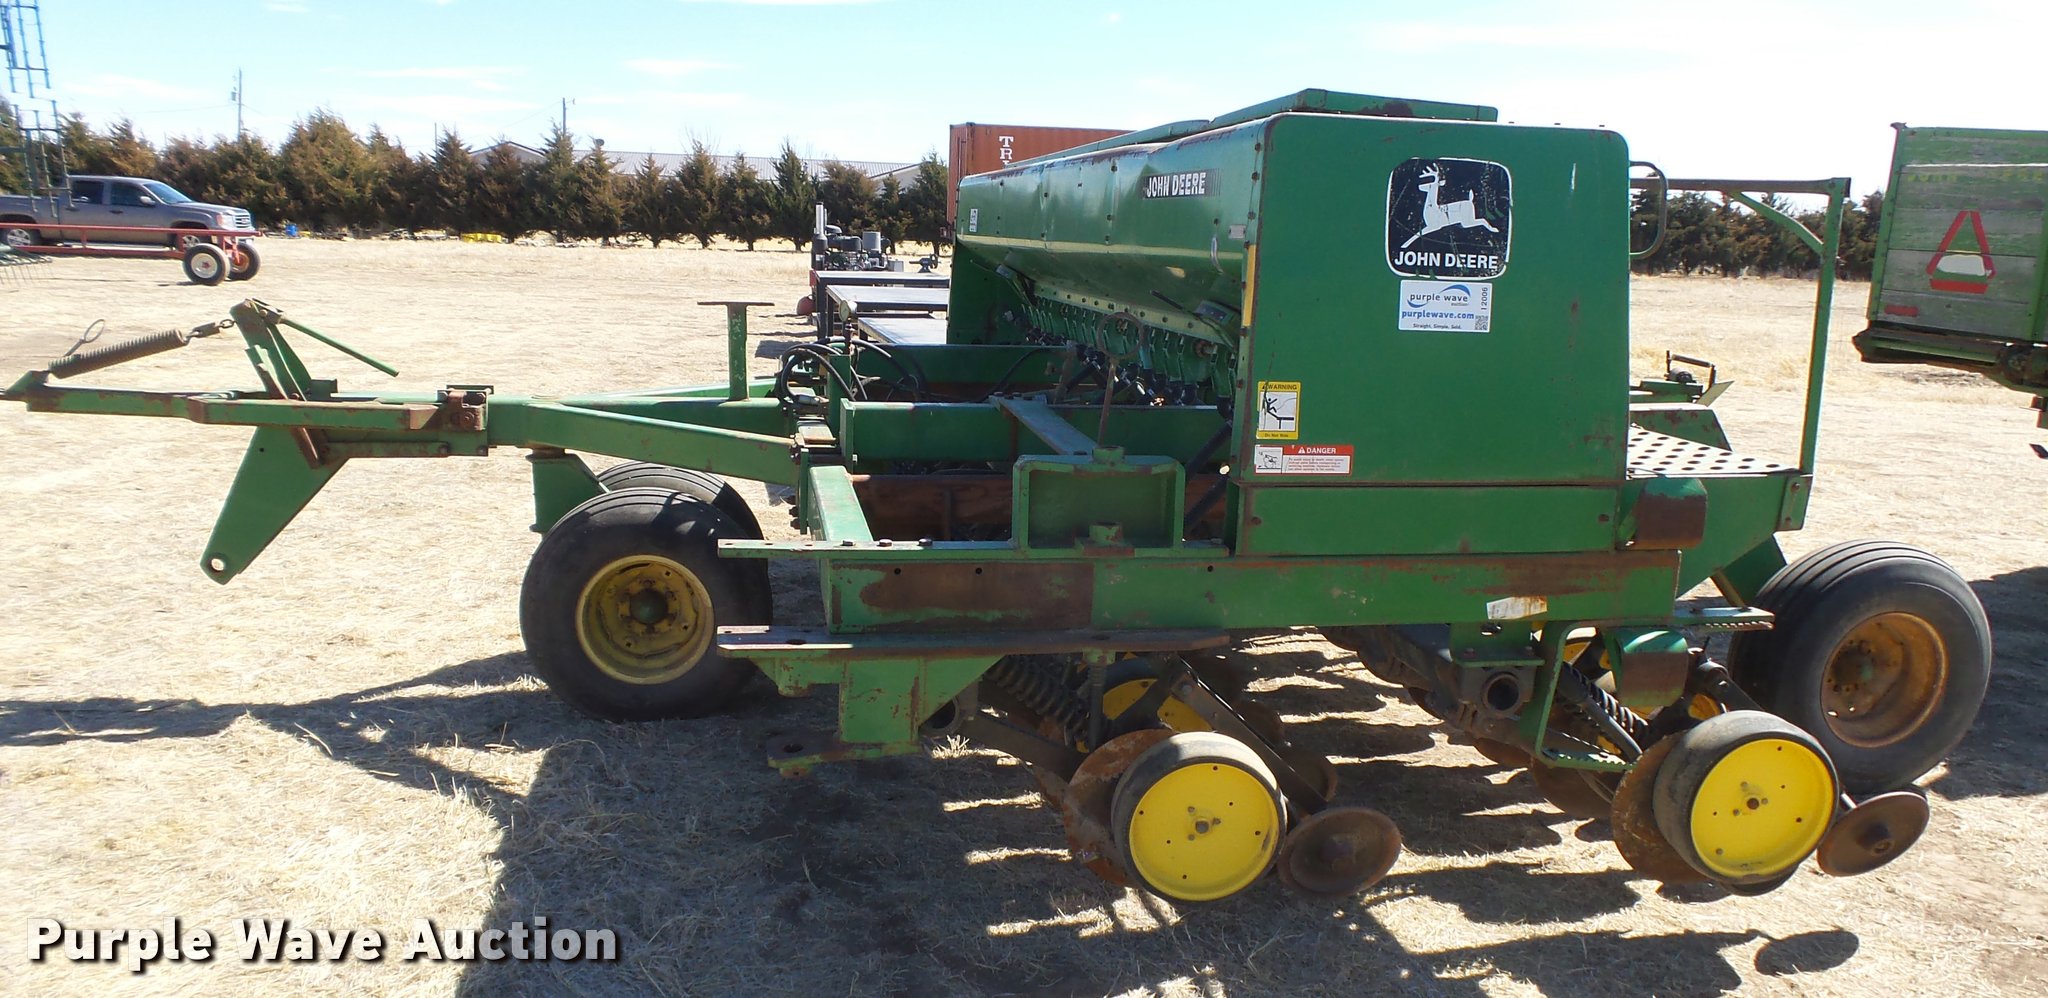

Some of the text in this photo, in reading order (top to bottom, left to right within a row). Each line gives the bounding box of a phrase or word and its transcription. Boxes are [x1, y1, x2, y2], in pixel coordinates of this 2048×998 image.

[1146, 172, 1207, 198] JOHN DEERE
[1394, 251, 1499, 269] JOHN DEERE
[1410, 293, 1441, 302] purple
[1401, 310, 1475, 320] purplewave.com
